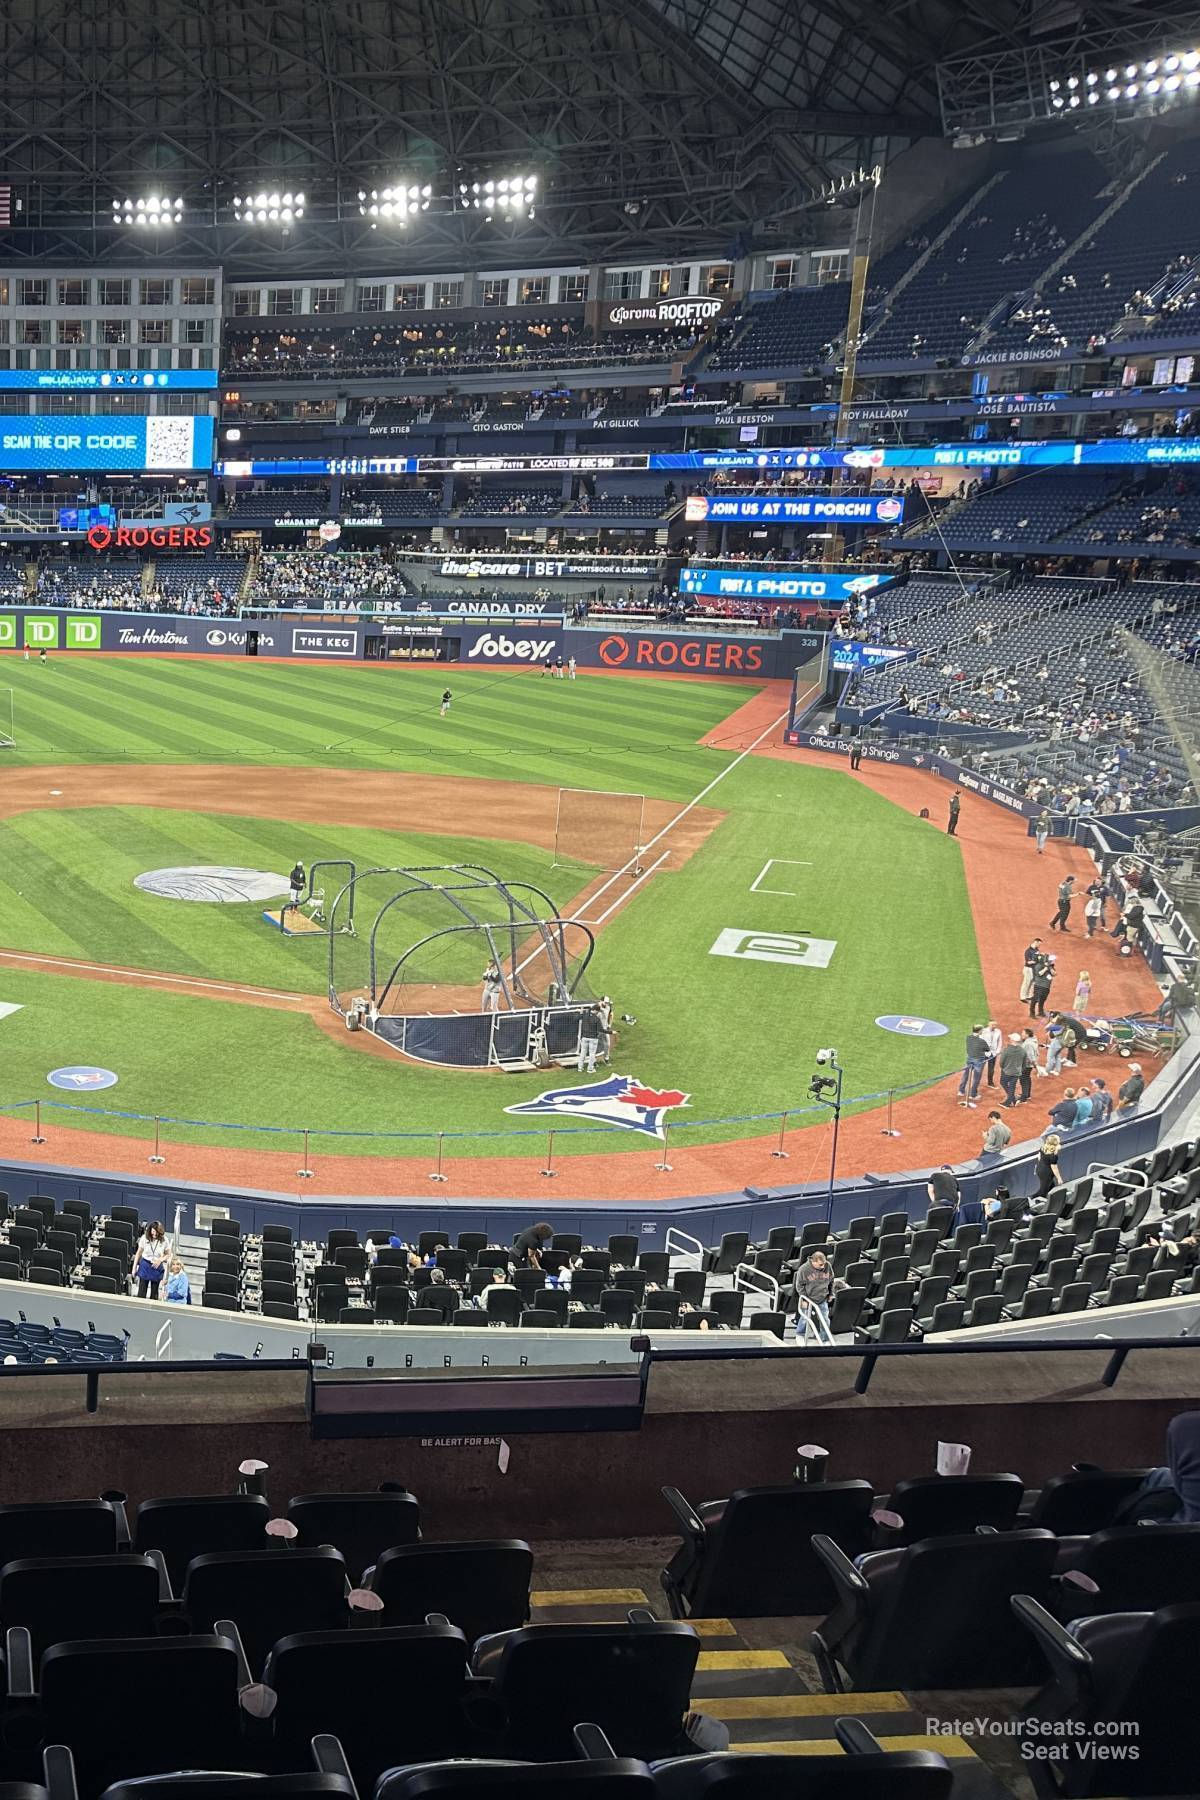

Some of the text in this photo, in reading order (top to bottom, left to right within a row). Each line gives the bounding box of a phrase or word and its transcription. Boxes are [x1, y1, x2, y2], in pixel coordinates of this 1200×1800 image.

[609, 302, 722, 324] Corona ROOFTOP
[675, 318, 702, 326] PATIO
[974, 349, 1060, 364] JACKIE ROBINSON
[842, 411, 860, 420] ROY
[862, 409, 909, 419] HALLADAY
[977, 402, 1056, 414] JOSÉ BAUTISTA
[593, 419, 640, 428] PAT GILLICK
[737, 415, 774, 423] BEESTON
[3, 435, 138, 451] SCAN THE QR CODE
[967, 450, 1020, 462] PHOTO
[530, 460, 568, 468] LOCATED
[711, 503, 737, 515] JOIN
[741, 503, 758, 515] US
[762, 503, 778, 515] AT
[785, 503, 809, 515] THE
[815, 503, 870, 516] PORCH!
[116, 527, 210, 547] ROGERS
[441, 562, 520, 574] theScore
[535, 562, 564, 576] BET
[757, 580, 825, 595] PHOTO
[448, 603, 546, 614] CANADA DRY
[28, 622, 55, 641] TD
[70, 622, 97, 641] TD
[119, 628, 188, 644] Tim Hortons
[300, 638, 350, 647] THE KEG
[468, 633, 556, 660] Sobeys
[801, 638, 817, 647] 328
[636, 640, 762, 670] ROGERS
[834, 650, 859, 662] 2024
[809, 736, 836, 749] Official
[837, 740, 867, 755] Roog
[869, 746, 899, 761] Shingle
[993, 789, 1013, 806] BASELINE
[1012, 799, 1023, 810] BOX
